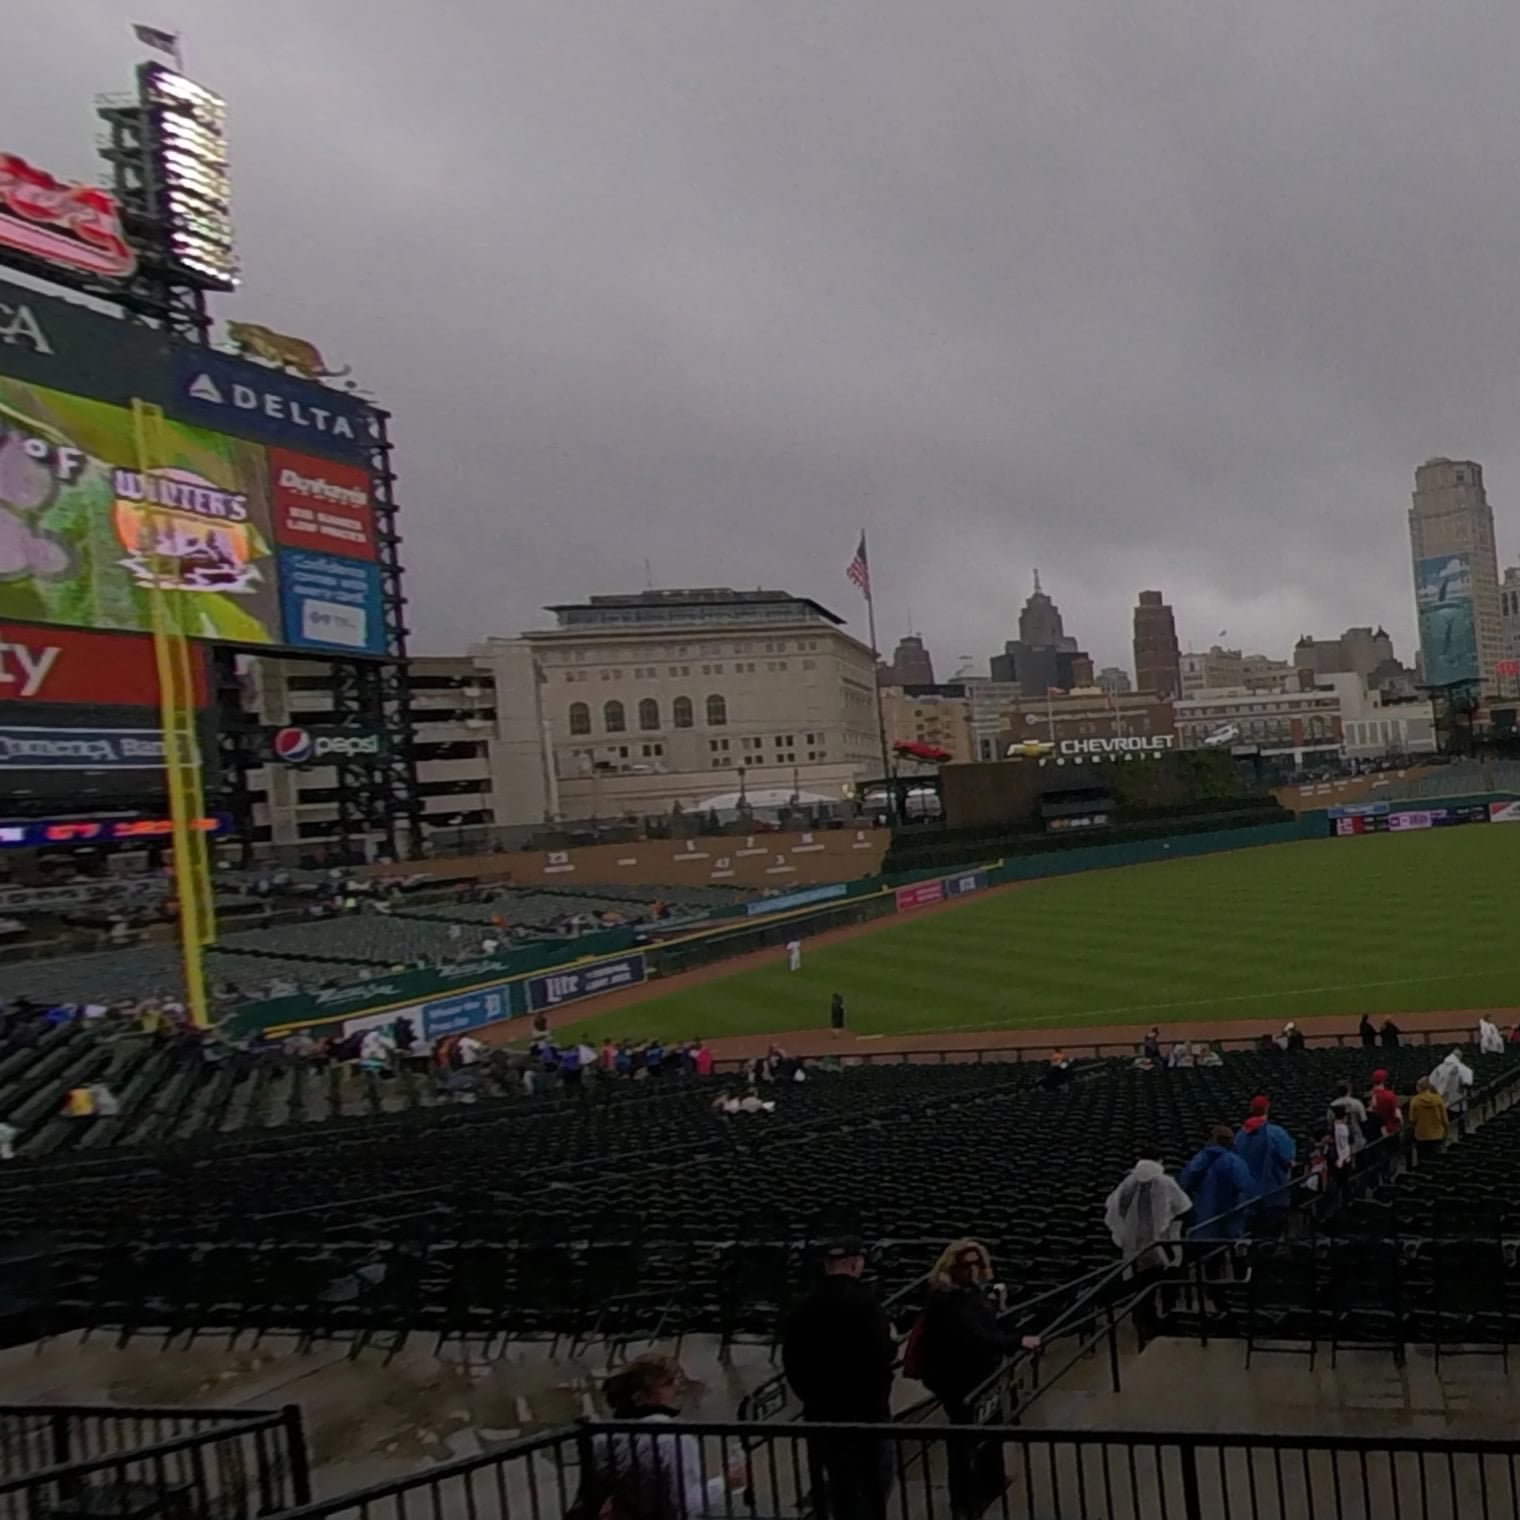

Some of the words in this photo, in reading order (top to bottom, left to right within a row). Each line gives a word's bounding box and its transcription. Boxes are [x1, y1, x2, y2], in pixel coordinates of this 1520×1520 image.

[231, 384, 354, 439] DELTA
[315, 734, 378, 757] pepsi
[1060, 735, 1174, 754] CHEVROLET
[545, 975, 579, 1003] Lite
